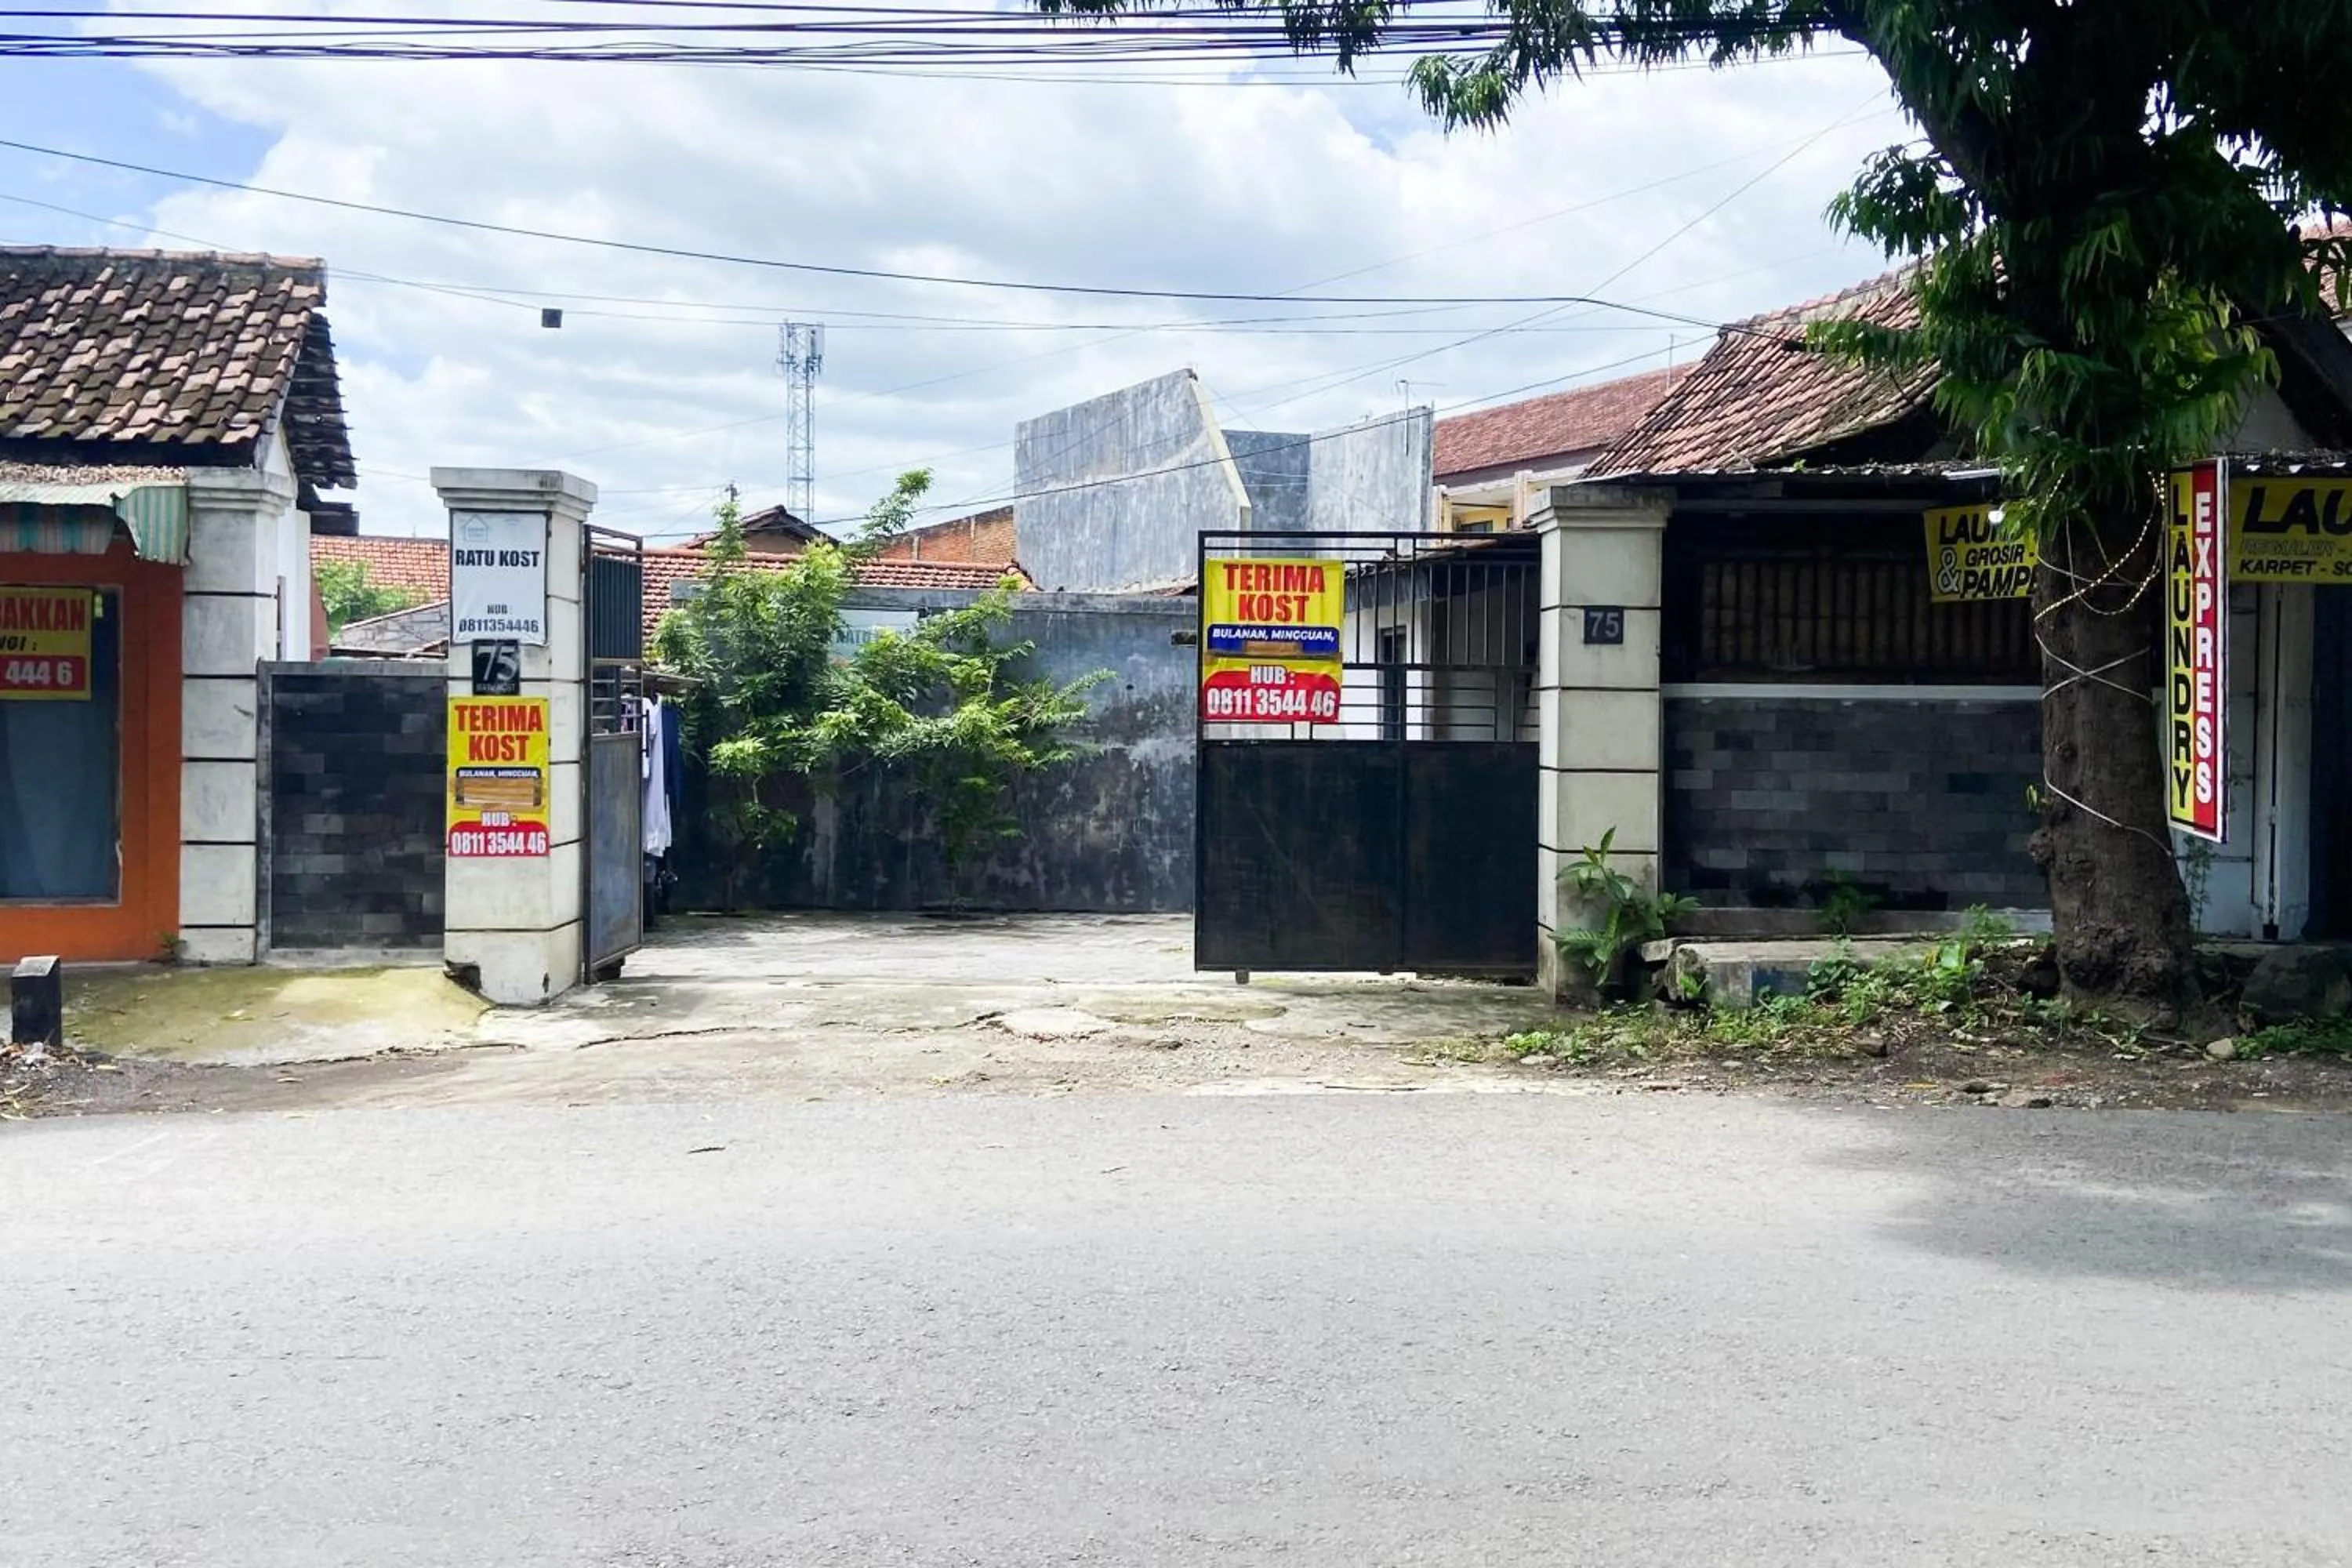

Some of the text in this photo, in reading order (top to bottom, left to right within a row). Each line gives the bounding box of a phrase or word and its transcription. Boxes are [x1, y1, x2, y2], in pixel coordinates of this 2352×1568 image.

[456, 550, 540, 568] RATU KOST
[1965, 544, 2025, 566] GROSIR
[2240, 559, 2317, 575] KARPET
[1223, 564, 1325, 593] TERIMA
[1239, 593, 1310, 622] KOST
[1213, 628, 1335, 642] BULANAN, MINGGUAN,
[1589, 612, 1619, 637] 75
[2172, 484, 2191, 808] LAUNDRY
[2195, 492, 2213, 804] EXPRESS
[477, 645, 517, 681] 75
[1207, 688, 1337, 717] 0811 3544 46
[455, 705, 543, 731] TERIMA
[468, 735, 529, 761] KOST
[452, 832, 546, 854] 0811 3544 46
